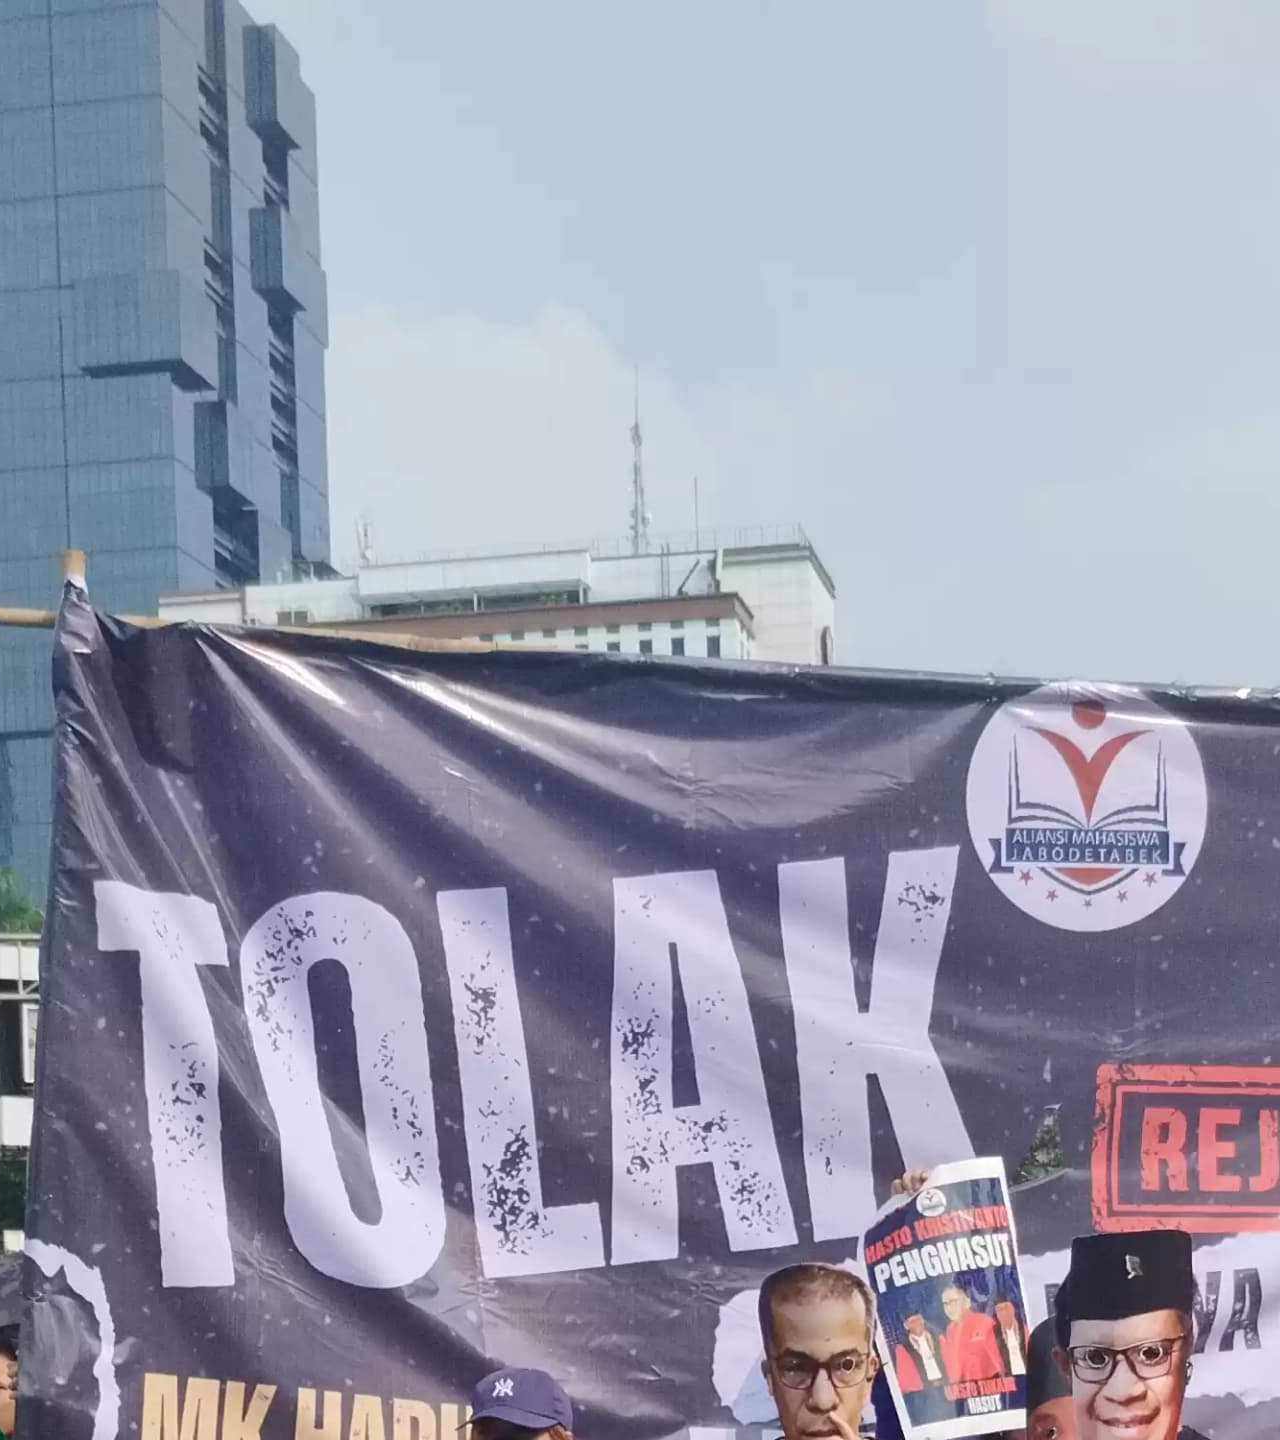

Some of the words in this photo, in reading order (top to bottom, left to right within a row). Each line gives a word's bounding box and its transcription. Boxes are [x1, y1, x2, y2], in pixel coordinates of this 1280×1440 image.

[1011, 847, 1162, 863] JABODETABEK
[1012, 829, 1068, 845] ALIANSI
[1072, 831, 1160, 846] MAHASISWA
[94, 846, 975, 1288] TOLAK
[865, 1225, 913, 1264] HASTO
[874, 1232, 1011, 1293] PENGHASUT
